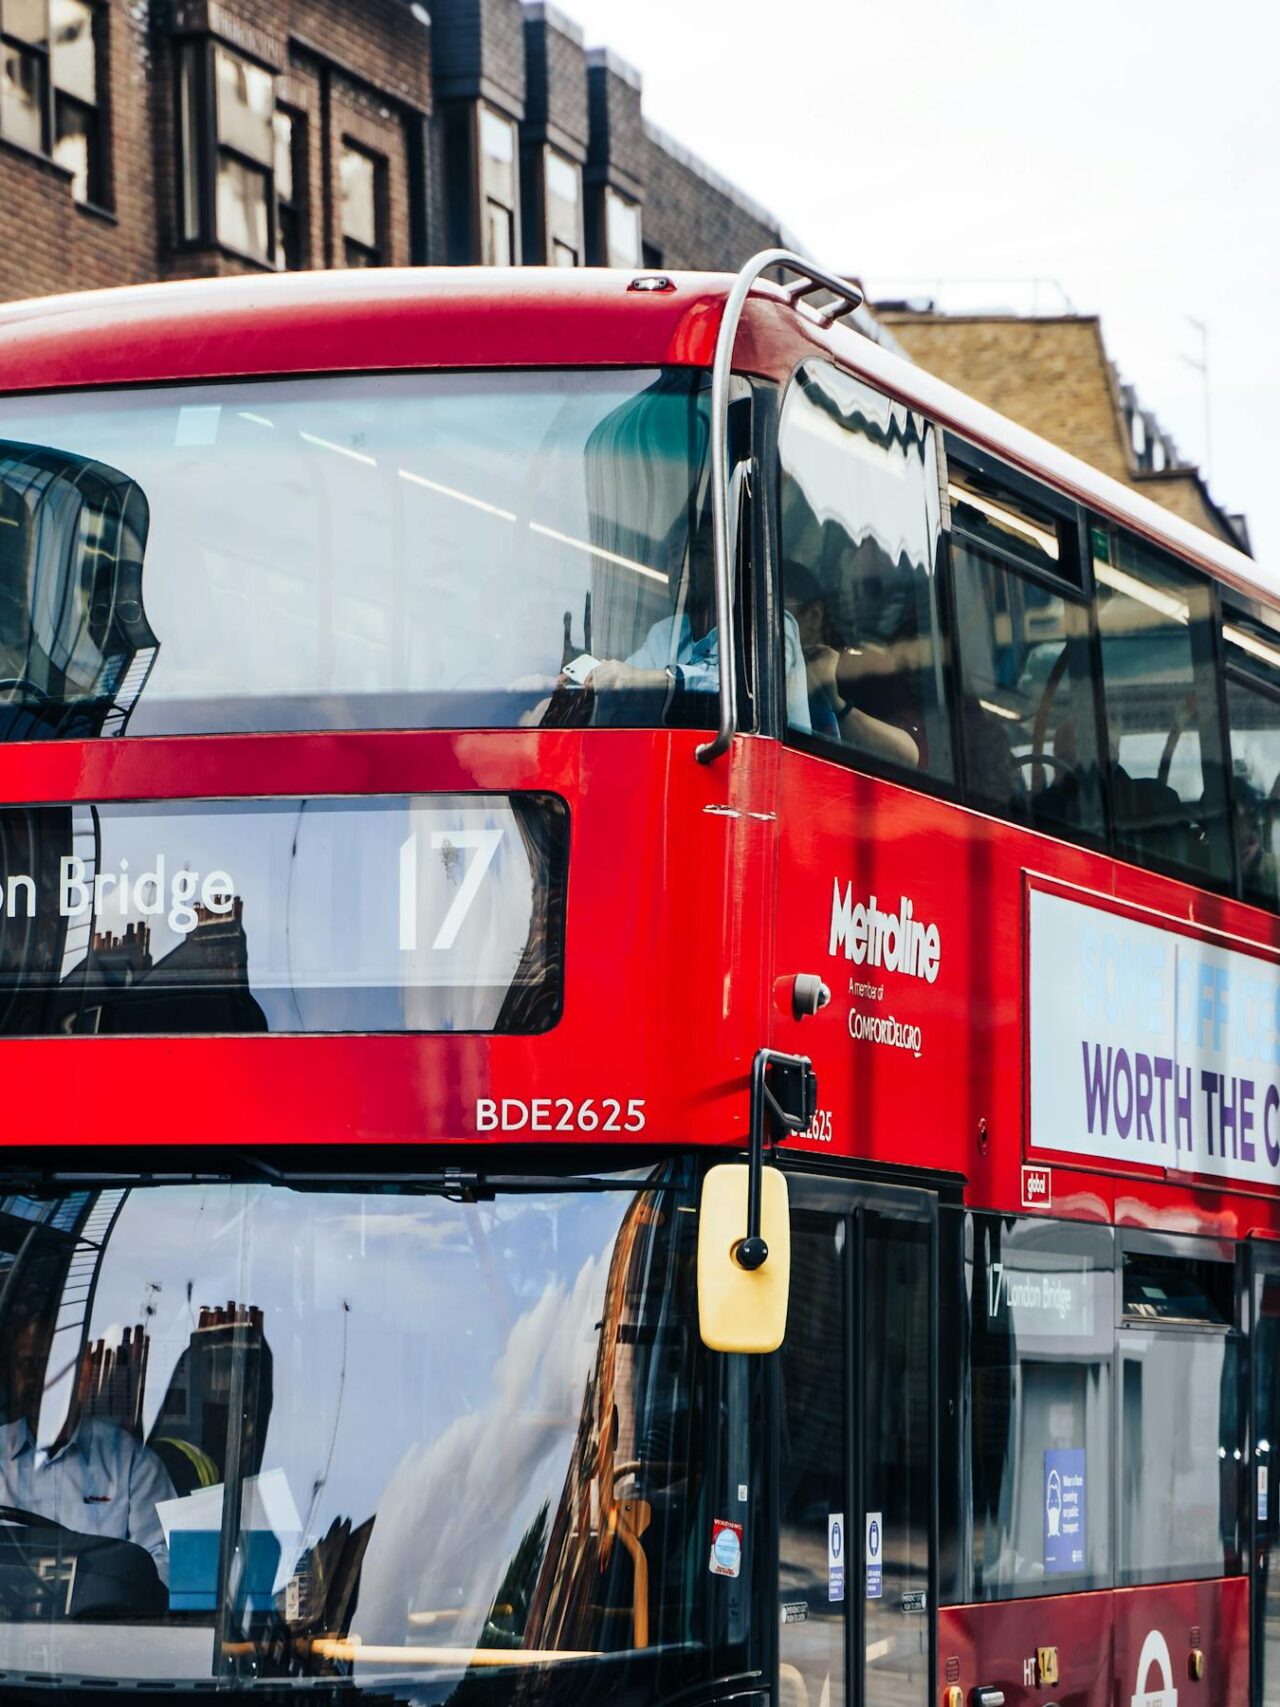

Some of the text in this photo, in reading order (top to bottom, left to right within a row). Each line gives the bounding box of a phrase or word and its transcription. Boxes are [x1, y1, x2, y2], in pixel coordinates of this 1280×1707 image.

[60, 853, 234, 934] Bridge
[399, 828, 505, 951] 17
[828, 876, 941, 983] Metroline
[848, 977, 884, 1001] A member of
[476, 1098, 646, 1132] BDE2625
[1081, 1040, 1193, 1152] WORTH
[1201, 1069, 1256, 1163] THE
[1027, 1173, 1046, 1200] global
[989, 1263, 1071, 1320] 17 London Bridge
[1023, 1657, 1036, 1688] HT
